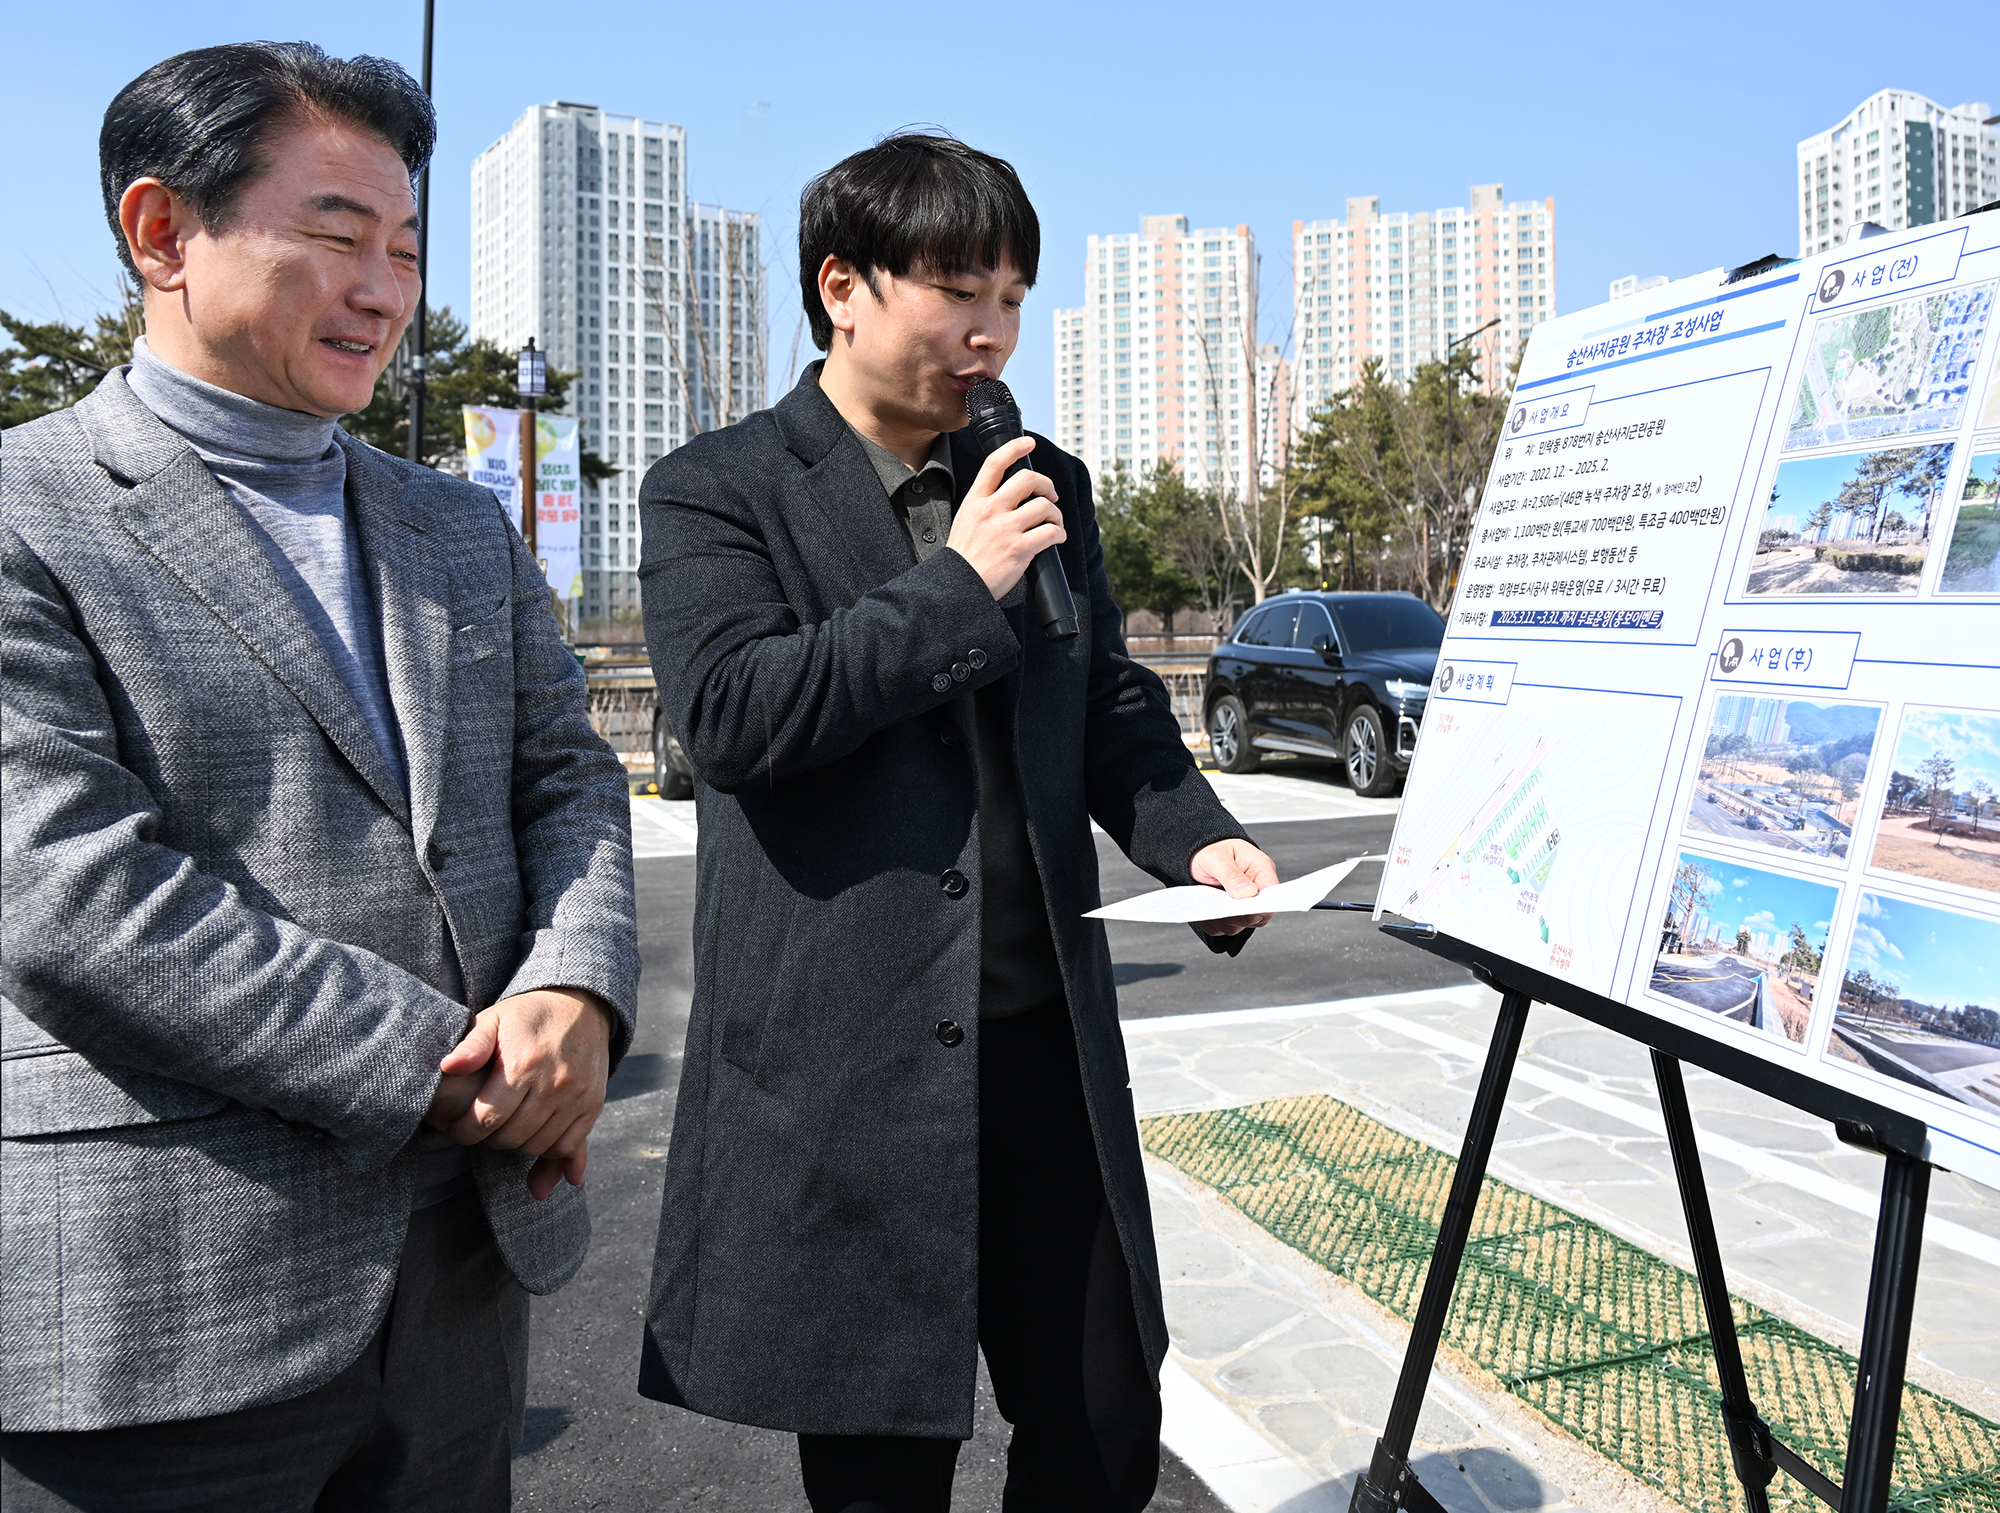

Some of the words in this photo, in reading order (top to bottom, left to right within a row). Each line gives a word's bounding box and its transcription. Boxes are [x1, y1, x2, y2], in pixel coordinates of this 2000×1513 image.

[1566, 334, 1632, 368] 송산사지공원
[1632, 324, 1670, 351] 주차장
[1670, 309, 1724, 339] 조성사업
[1529, 403, 1570, 425] 사업개요
[1504, 447, 1513, 460] 위
[1525, 444, 1536, 456] 치:
[1538, 438, 1561, 455] 민락동
[1562, 432, 1595, 450] 878번지
[1595, 419, 1666, 446] 송산사지근린공원
[1497, 473, 1527, 488] 사업기간:
[1530, 467, 1551, 482] 2022.
[1553, 466, 1566, 479] 12.
[1575, 461, 1598, 475] 2025.
[1601, 459, 1609, 471] 2.
[1489, 499, 1519, 515] 사업규모:
[1585, 489, 1603, 503] 녹색
[1603, 484, 1631, 501] 주차장
[1632, 482, 1652, 499] 조성,
[1663, 482, 1685, 496] 장애인
[1685, 475, 1703, 494] 2면)
[1481, 527, 1510, 543] 총사업비:
[1513, 522, 1551, 539] 1,100백만
[1552, 518, 1587, 537] 원(특교세
[1590, 514, 1635, 532] 700백만원,
[1638, 511, 1667, 529] 특조금
[1669, 506, 1727, 526] 400백만원)
[1473, 556, 1502, 570] 주요시설:
[1505, 552, 1530, 569] 주차장,
[1531, 549, 1588, 566] 주차관제시스템,
[1590, 548, 1627, 564] 보행동선
[1628, 546, 1638, 563] 등
[1465, 583, 1496, 598] 운영방법:
[1498, 580, 1549, 597] 의정부도시공사
[1551, 578, 1604, 597] 위탁운영(유료
[1605, 579, 1613, 594] /
[1614, 578, 1640, 595] 3시간
[1641, 577, 1667, 596] 무료)
[1458, 611, 1488, 627] 기타사항:
[1577, 610, 1663, 629] 무료운영(홍보이벤트)
[1456, 673, 1496, 692] 사업계획
